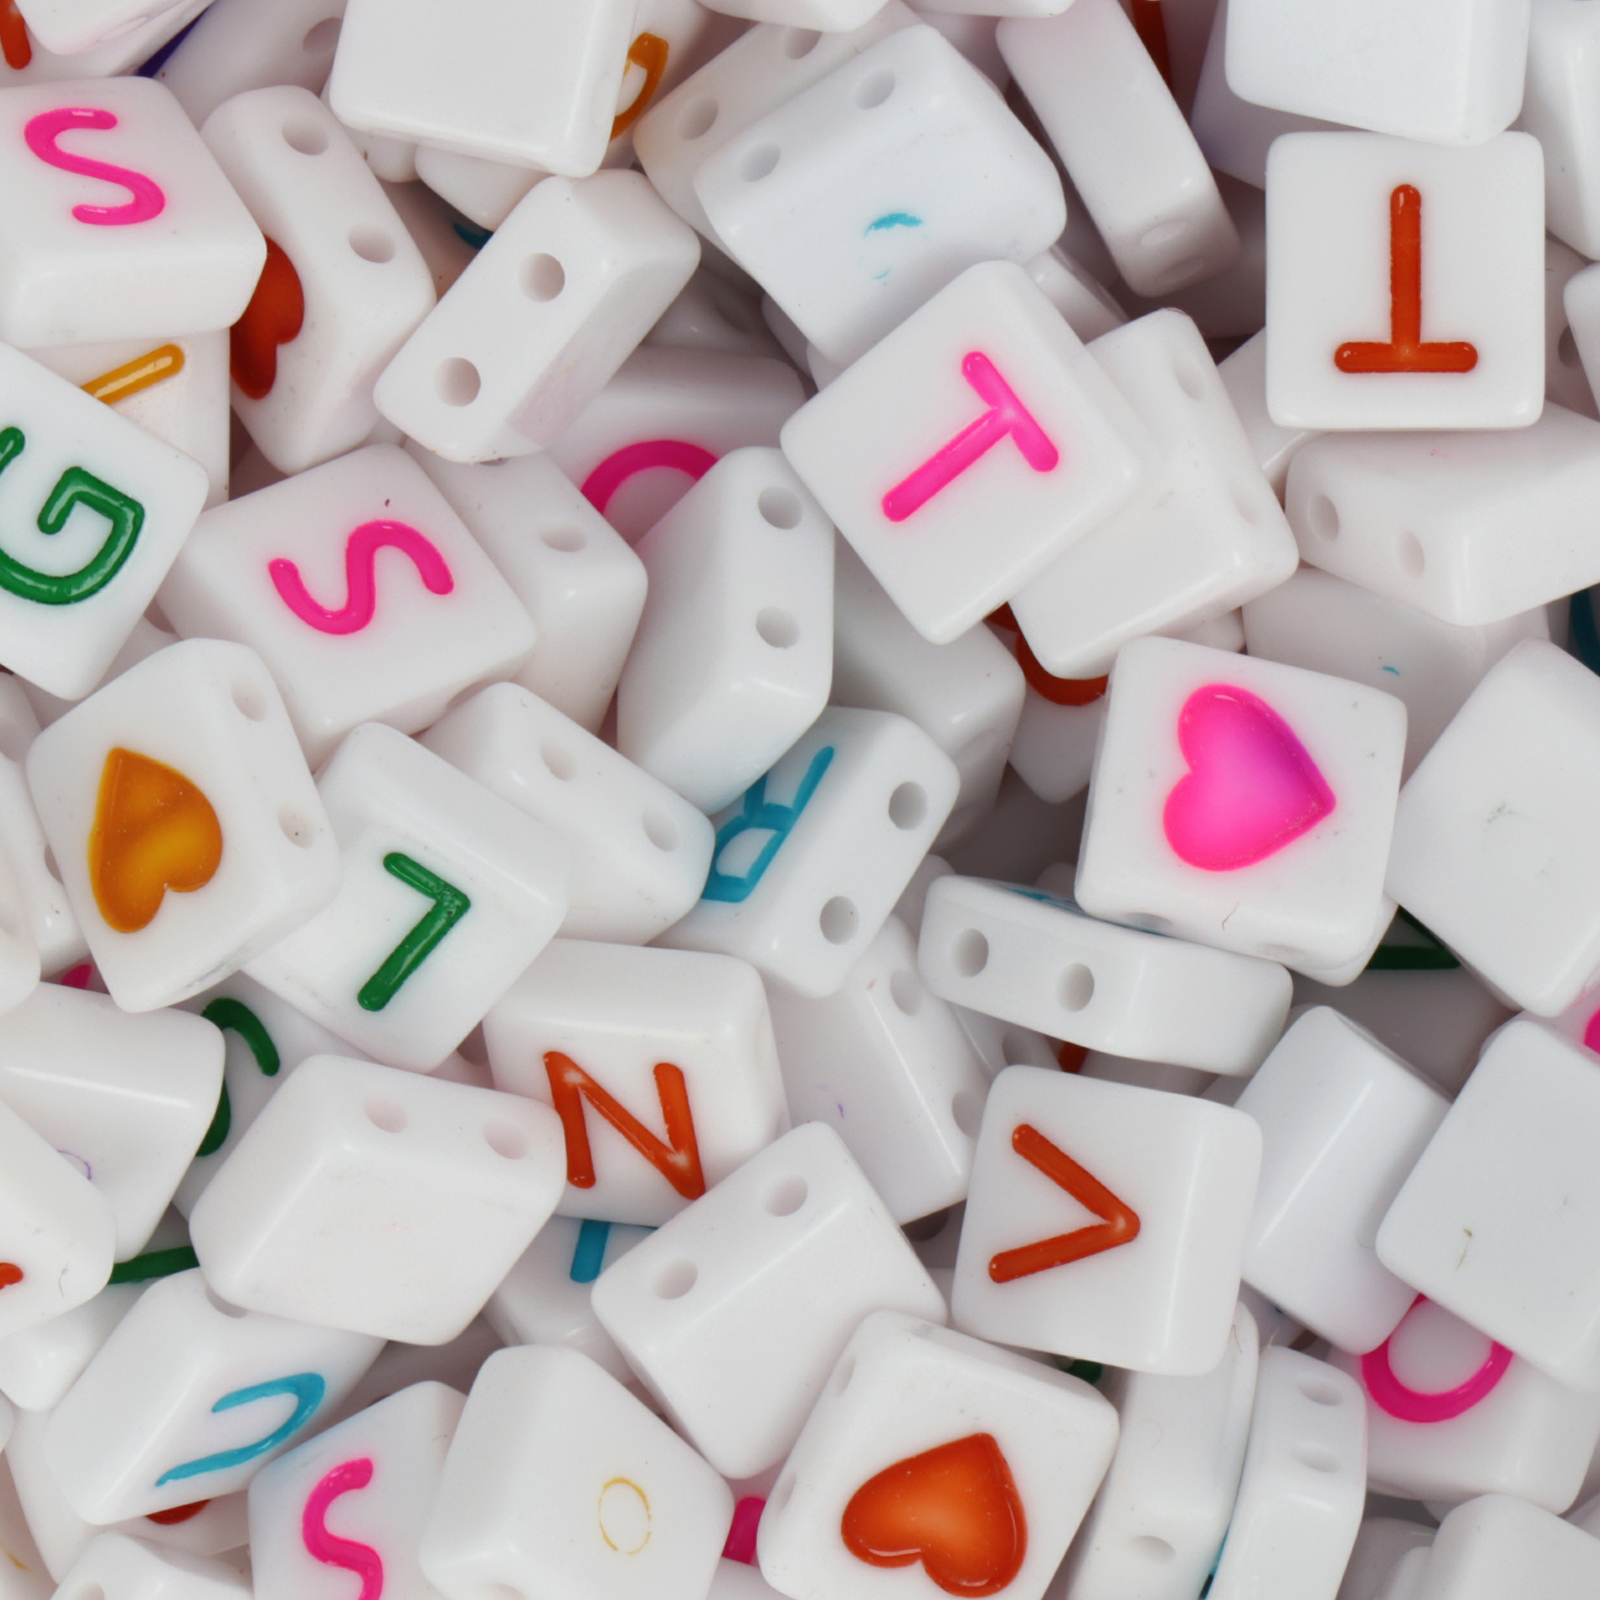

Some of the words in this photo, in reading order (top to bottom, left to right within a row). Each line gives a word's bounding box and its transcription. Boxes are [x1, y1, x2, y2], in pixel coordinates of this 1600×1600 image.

[24, 107, 167, 227] S
[1334, 184, 1479, 374] T
[0, 426, 145, 605] G
[881, 350, 1061, 523] T
[267, 518, 455, 637] S
[701, 746, 835, 904] R
[357, 852, 471, 1012] L
[543, 1050, 707, 1201] N
[988, 1123, 1141, 1284] V
[301, 1457, 385, 1600] S
